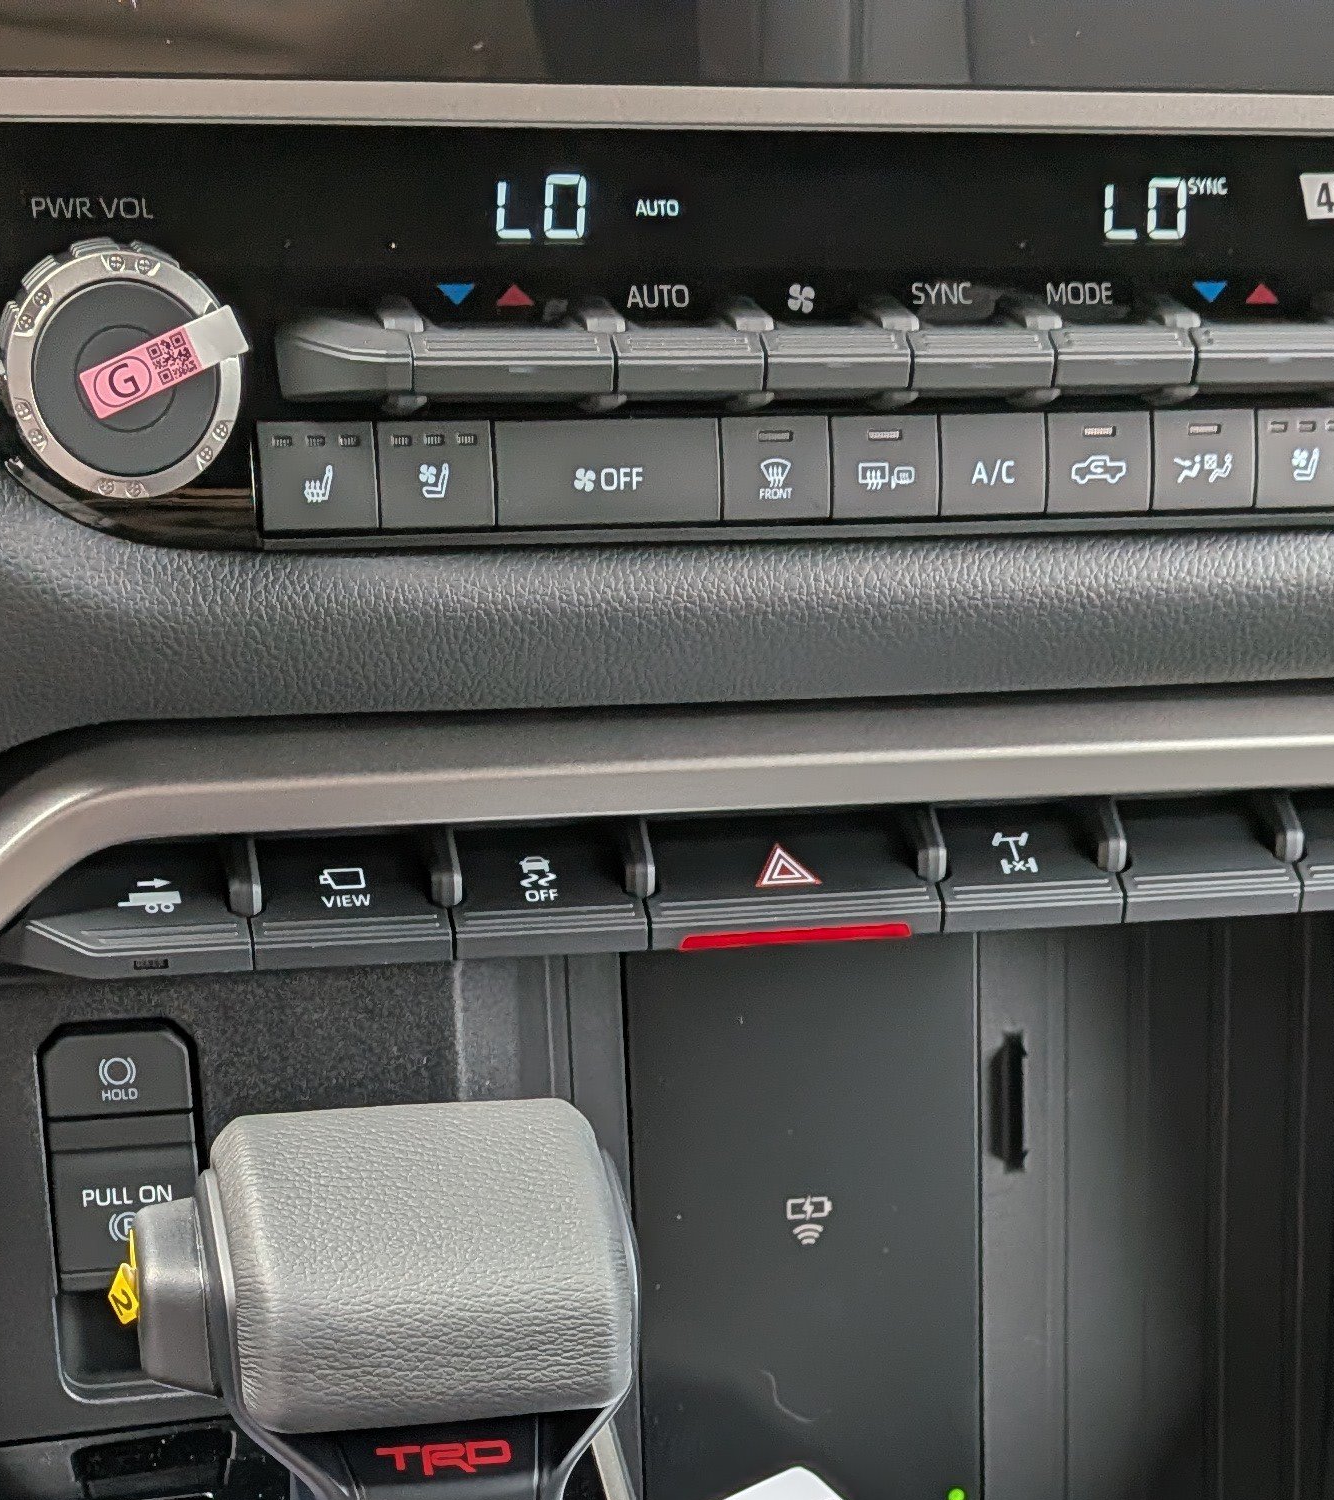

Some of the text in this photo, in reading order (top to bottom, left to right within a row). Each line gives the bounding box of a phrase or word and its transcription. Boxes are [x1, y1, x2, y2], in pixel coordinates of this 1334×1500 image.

[1188, 177, 1228, 196] SYNC
[31, 197, 154, 219] PWR VOL
[635, 199, 680, 217] AUTO
[626, 284, 690, 309] AUTO
[912, 281, 973, 306] SYNC
[1046, 281, 1113, 305] MODE
[108, 362, 141, 399] G
[600, 466, 644, 491] OFF
[971, 460, 1016, 485] A/C
[759, 487, 793, 500] FRONT
[321, 893, 371, 908] VIEW
[525, 888, 559, 902] OFF
[101, 1088, 138, 1101] HOLD
[82, 1184, 173, 1207] PULL ON
[376, 1438, 513, 1477] TRD
